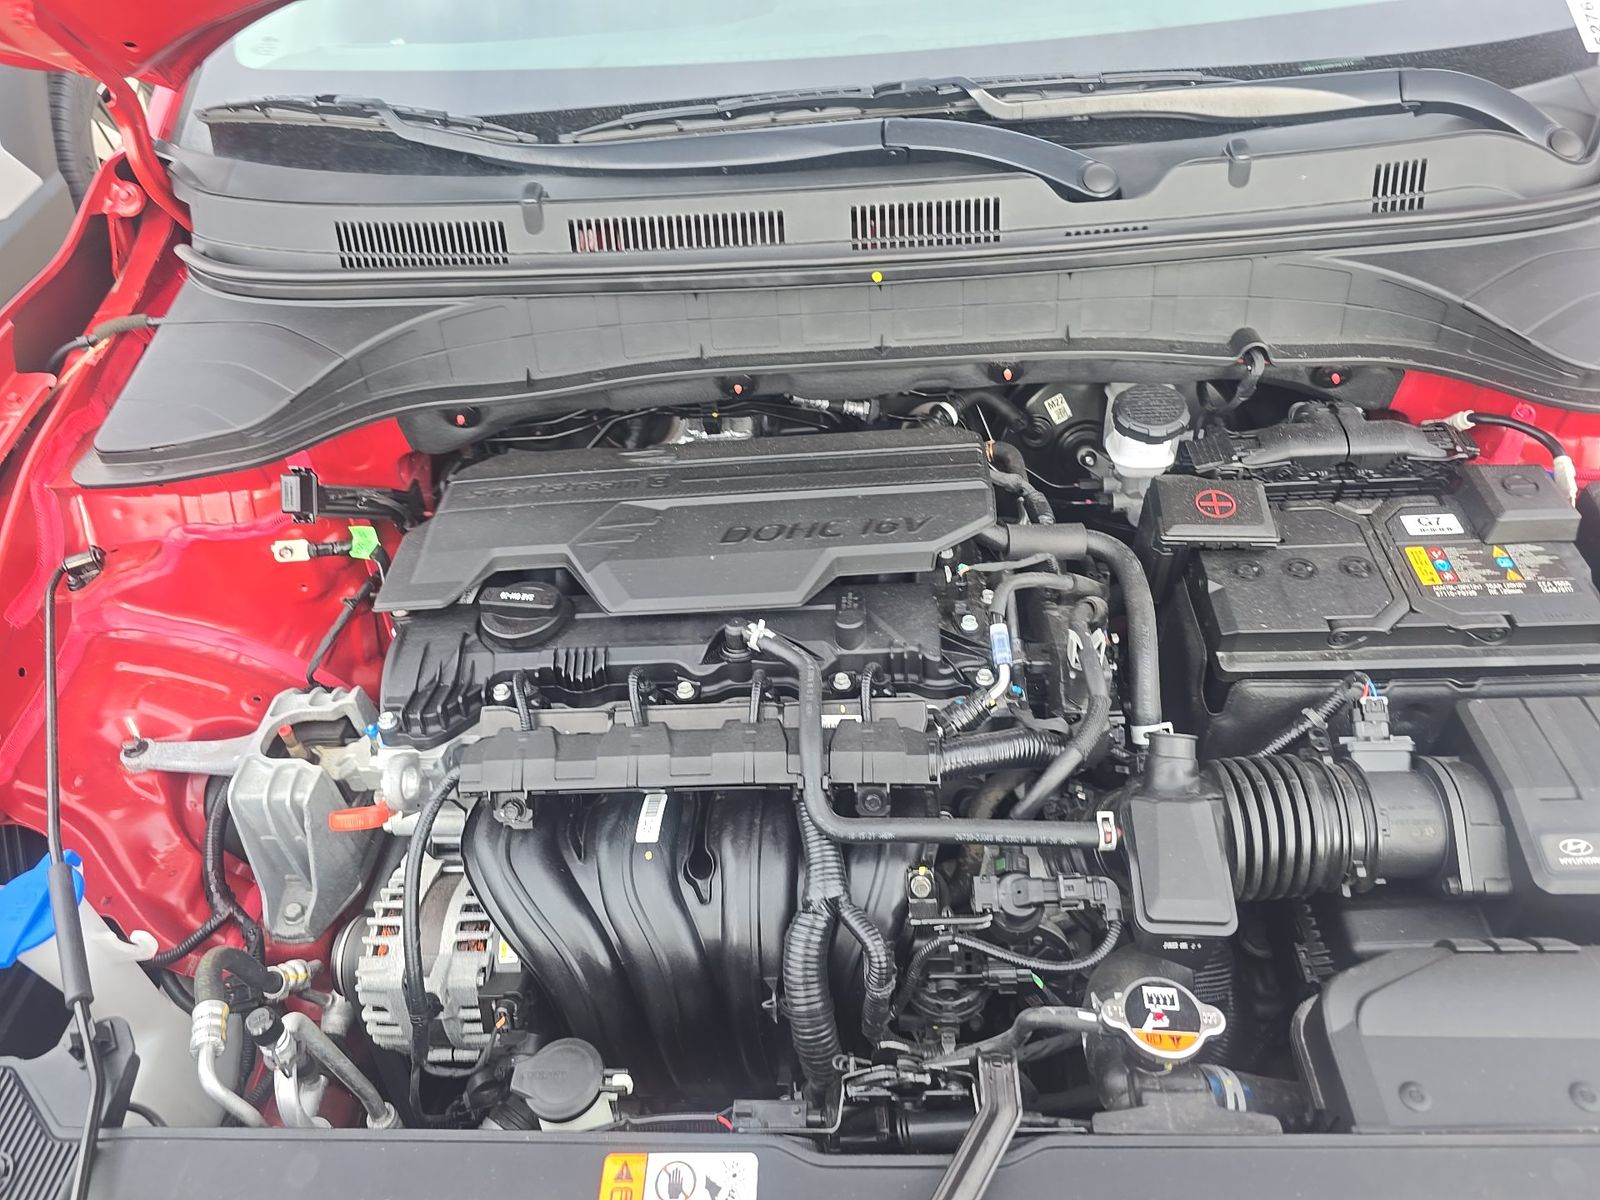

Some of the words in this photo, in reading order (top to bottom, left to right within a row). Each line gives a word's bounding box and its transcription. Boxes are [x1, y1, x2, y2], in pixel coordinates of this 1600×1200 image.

[1416, 516, 1441, 528] G7
[719, 518, 851, 545] DOHC
[860, 515, 935, 538] 16V
[1559, 856, 1600, 865] HYUNDA
